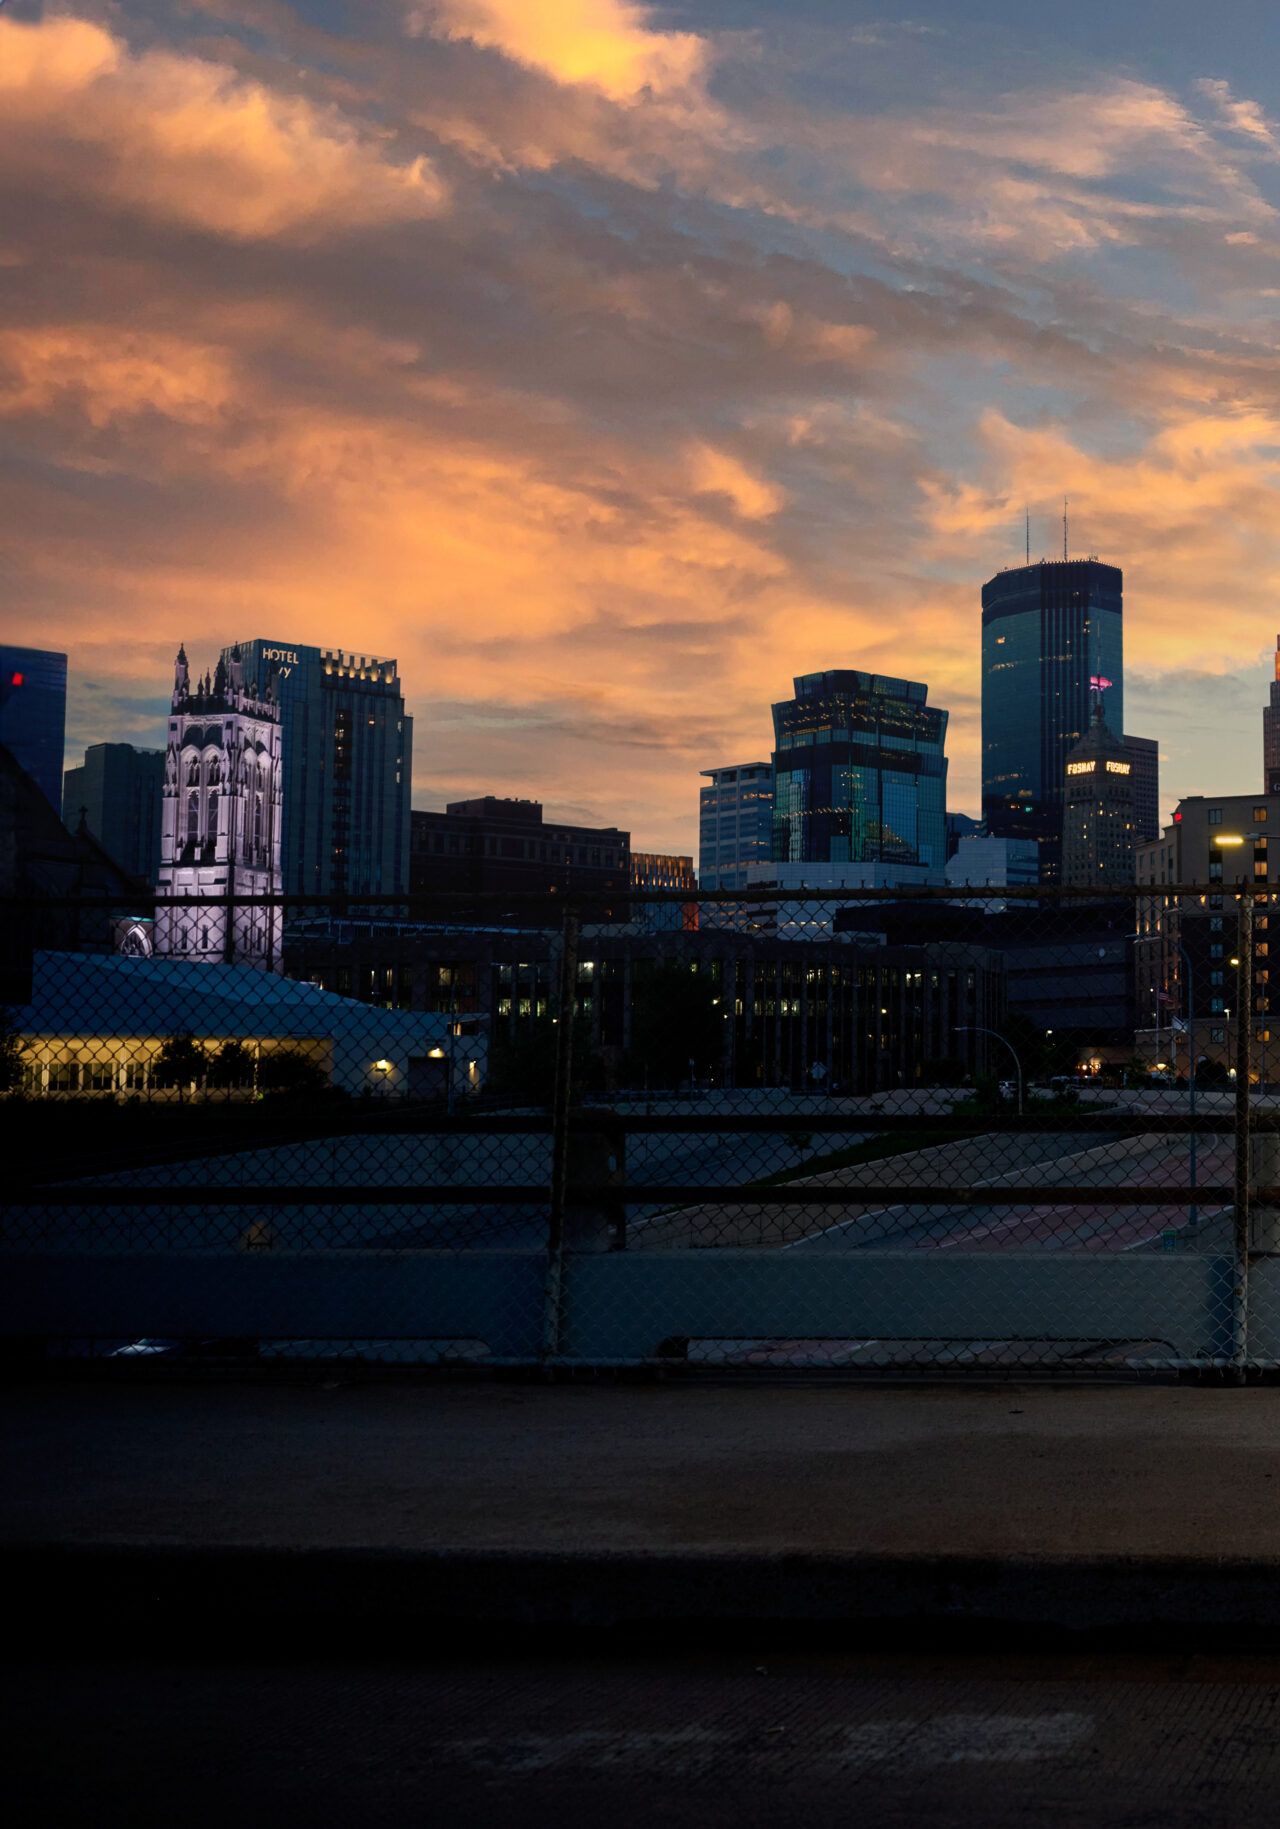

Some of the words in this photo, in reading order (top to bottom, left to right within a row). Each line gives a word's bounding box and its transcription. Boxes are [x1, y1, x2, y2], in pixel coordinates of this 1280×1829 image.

[263, 647, 300, 664] HOTEL
[1067, 760, 1096, 775] FOSHAY
[1106, 760, 1131, 775] FOSHAY
